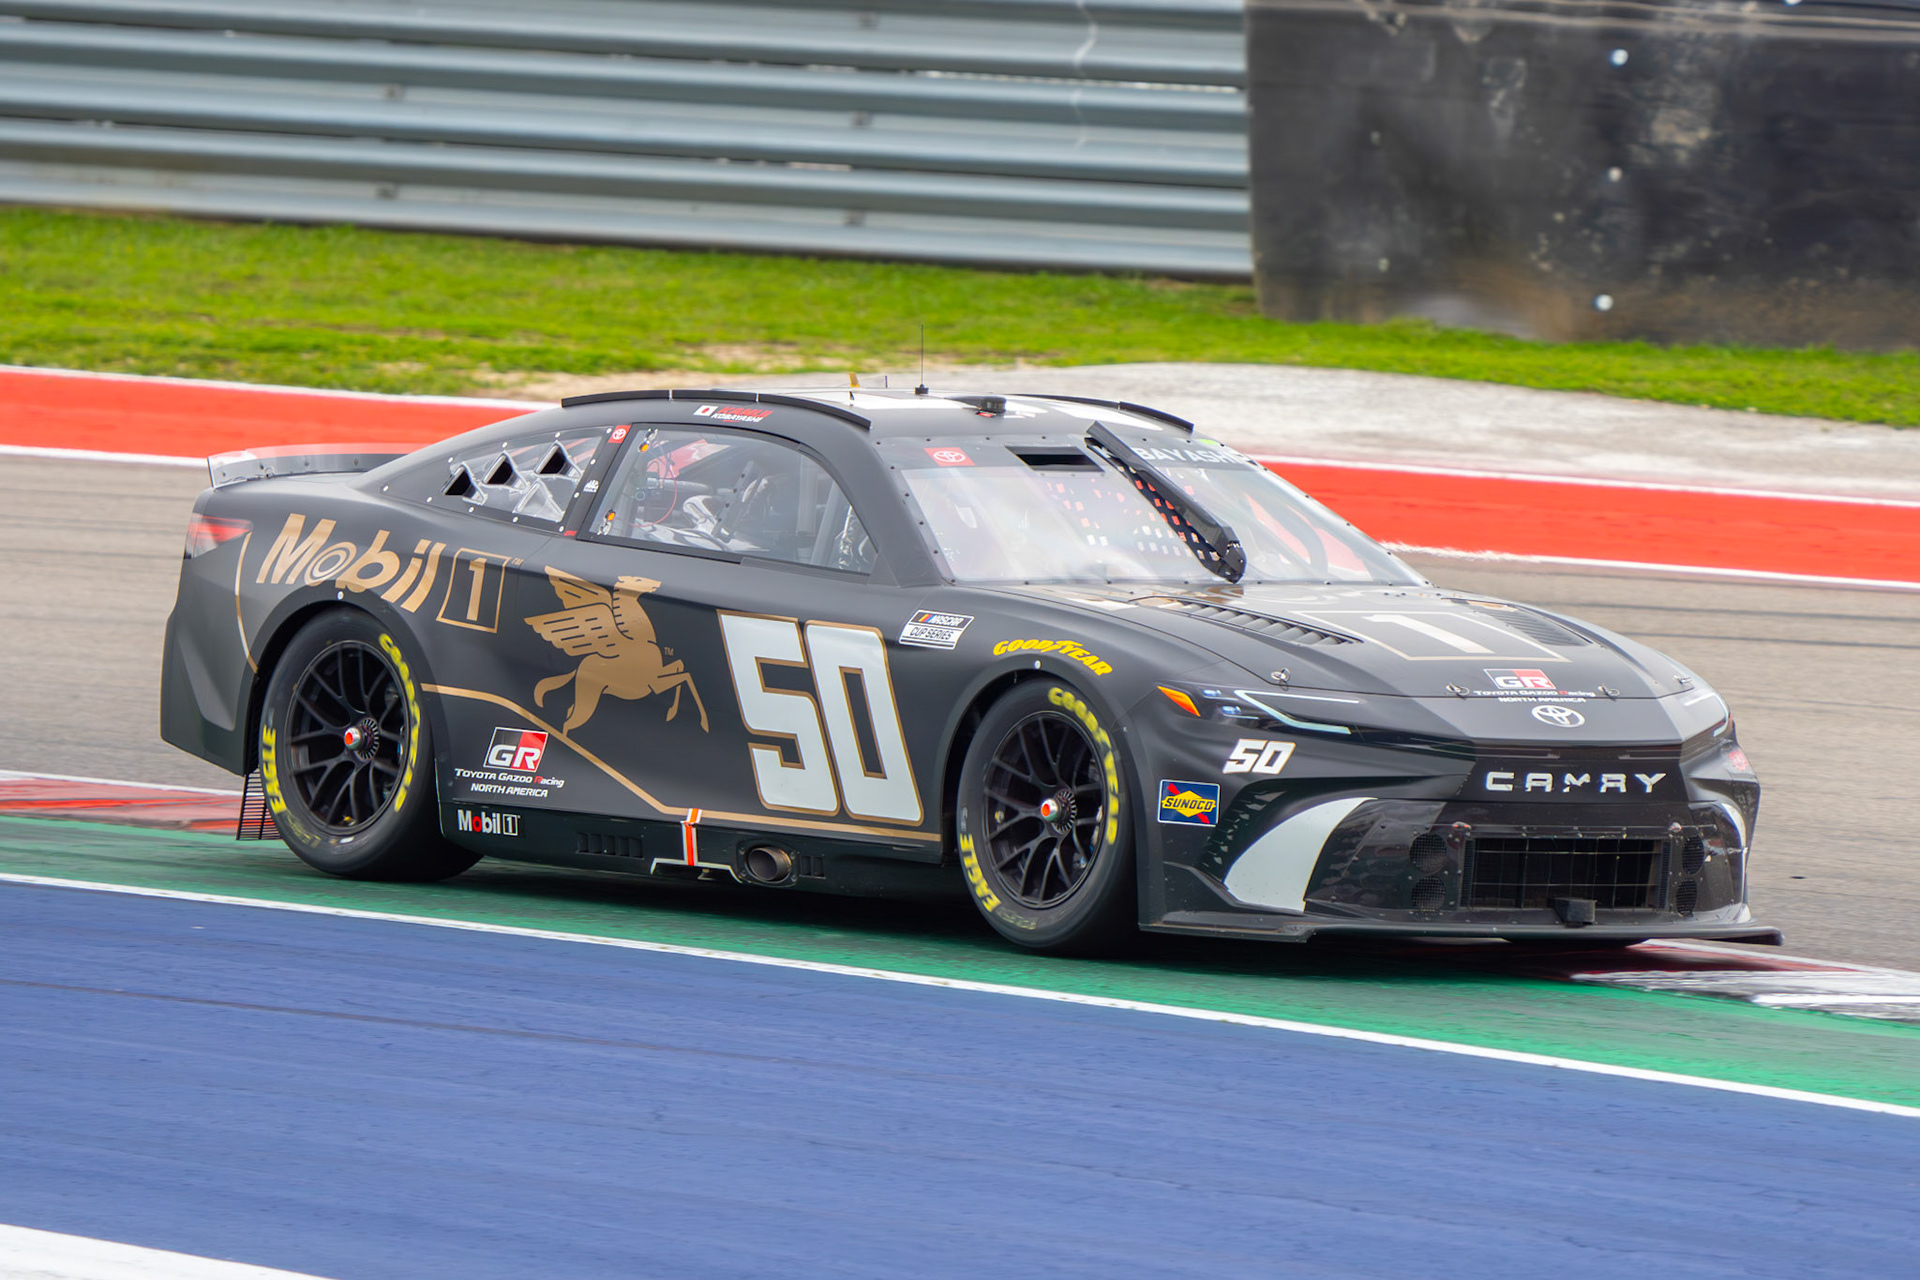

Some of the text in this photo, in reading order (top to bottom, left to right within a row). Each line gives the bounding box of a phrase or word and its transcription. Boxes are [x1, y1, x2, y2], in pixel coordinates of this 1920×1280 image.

[711, 413, 763, 423] KOBAYASHI
[717, 406, 773, 418] KAMUI
[255, 513, 447, 613] Mobil
[466, 558, 488, 622] 1
[928, 615, 964, 627] NASCAR
[910, 627, 954, 640] CUP SERIES
[993, 639, 1113, 676] GOODYEAR
[1495, 676, 1551, 689] GR
[716, 609, 924, 827] 50
[488, 744, 540, 769] GR
[1222, 738, 1296, 775] 50
[454, 768, 565, 788] TOYOTA GAZOO Racing
[1485, 771, 1667, 793] CAMRY
[470, 783, 549, 798] NORTH AMERICA
[1164, 797, 1214, 811] SUNOCO
[457, 809, 501, 835] Mobil
[960, 833, 1002, 913] EAGLE
